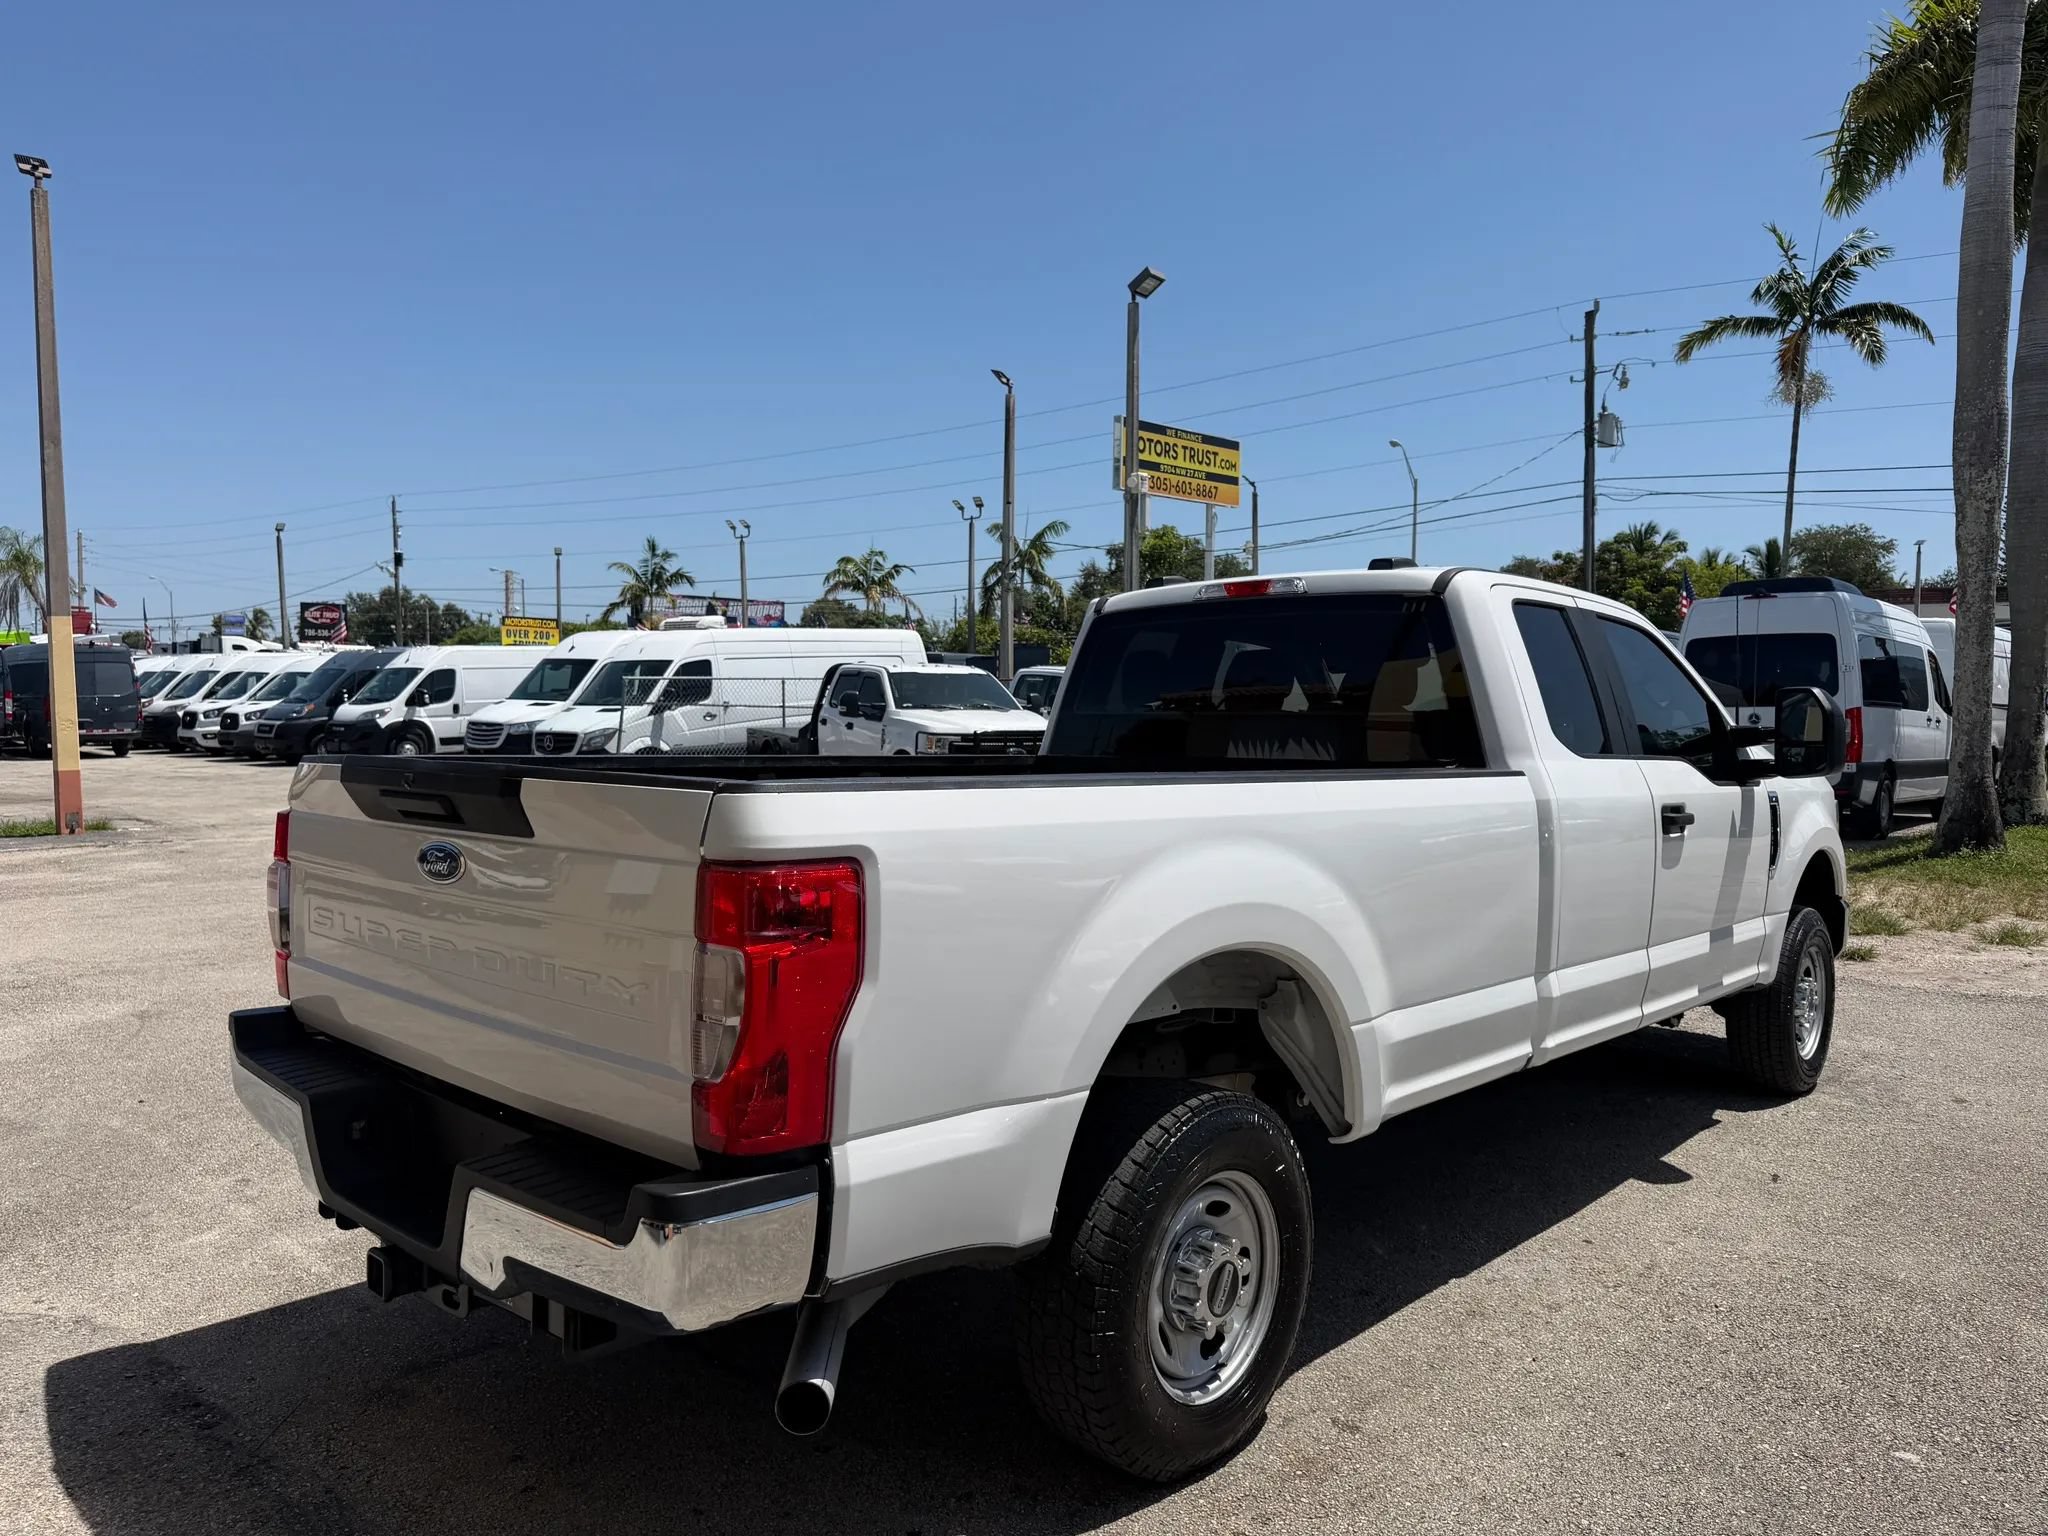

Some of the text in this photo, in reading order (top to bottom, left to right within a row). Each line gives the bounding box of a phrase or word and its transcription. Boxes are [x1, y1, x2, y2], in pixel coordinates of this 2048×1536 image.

[1166, 428, 1203, 443] WE FINANCE
[1138, 436, 1237, 472] OTORS TRUST.COM
[1175, 467, 1187, 476] NW
[1194, 471, 1207, 480] AVE
[1148, 475, 1219, 500] 305)-603-8867
[506, 629, 529, 639] OVER
[312, 905, 650, 1006] SUPER DUTY
